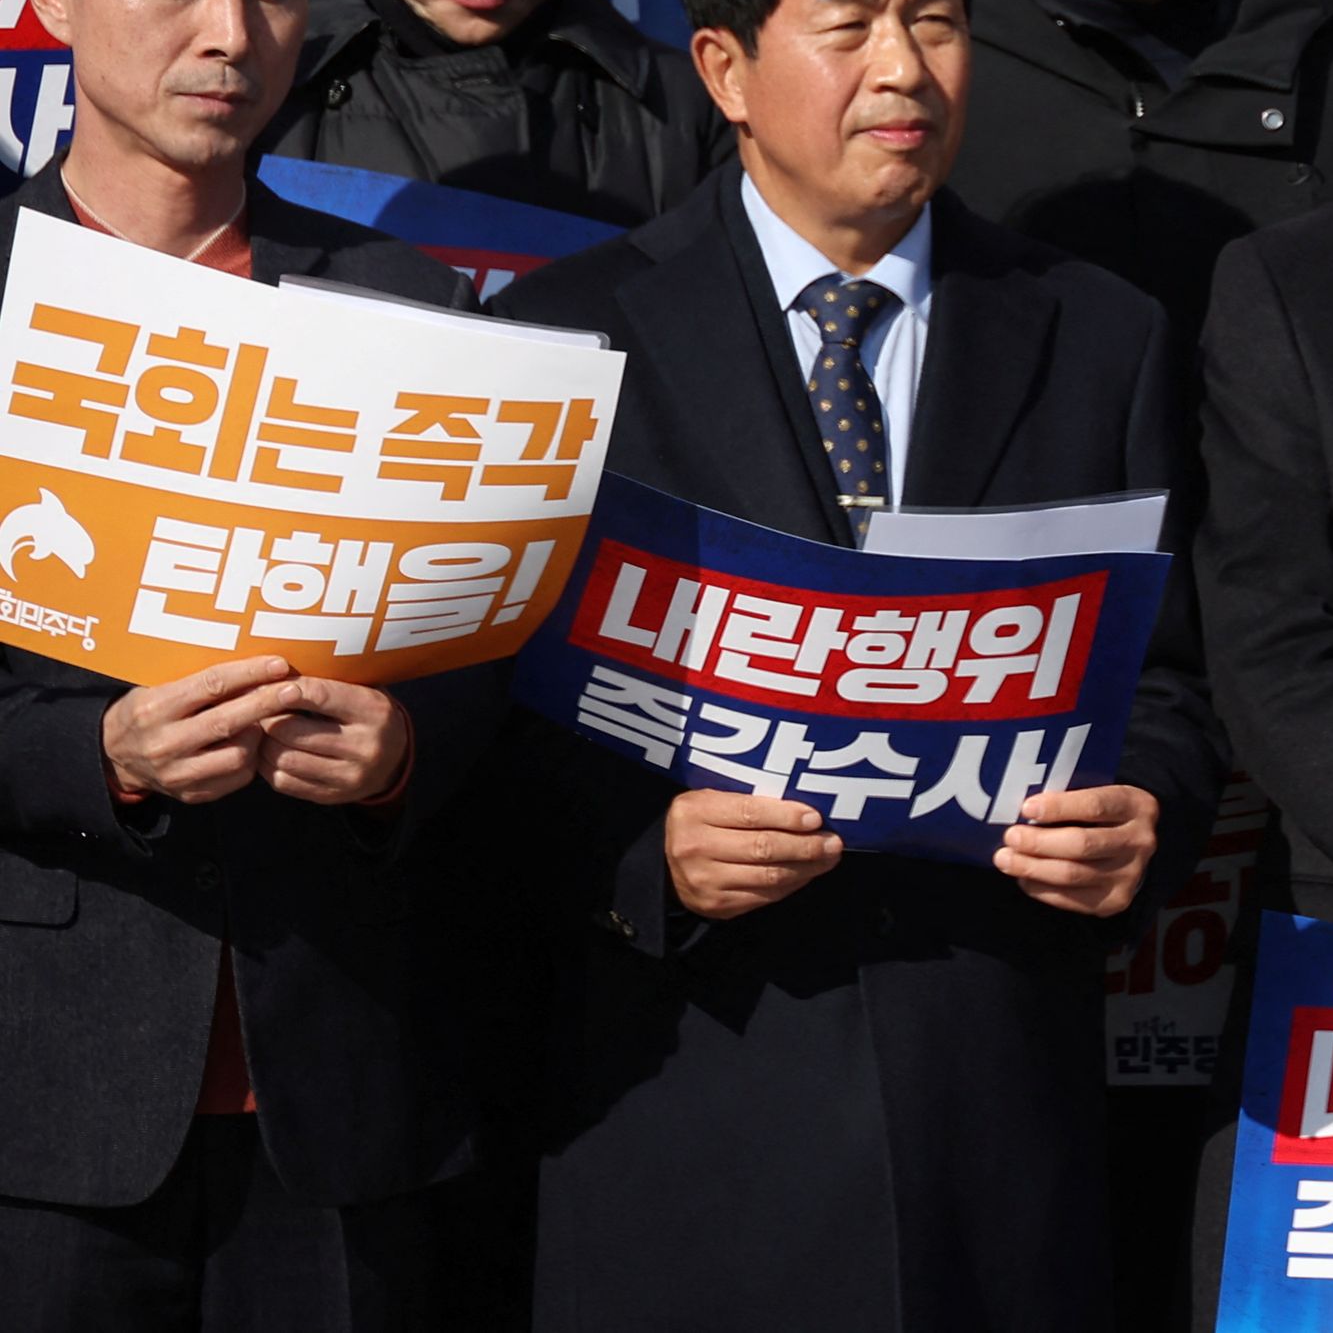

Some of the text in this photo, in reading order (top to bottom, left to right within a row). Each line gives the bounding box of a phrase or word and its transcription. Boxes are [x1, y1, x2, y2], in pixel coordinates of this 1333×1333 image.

[7, 302, 600, 503] 국회는 즉각
[127, 514, 557, 657] 탄핵을!
[597, 561, 1083, 706] 내란행위
